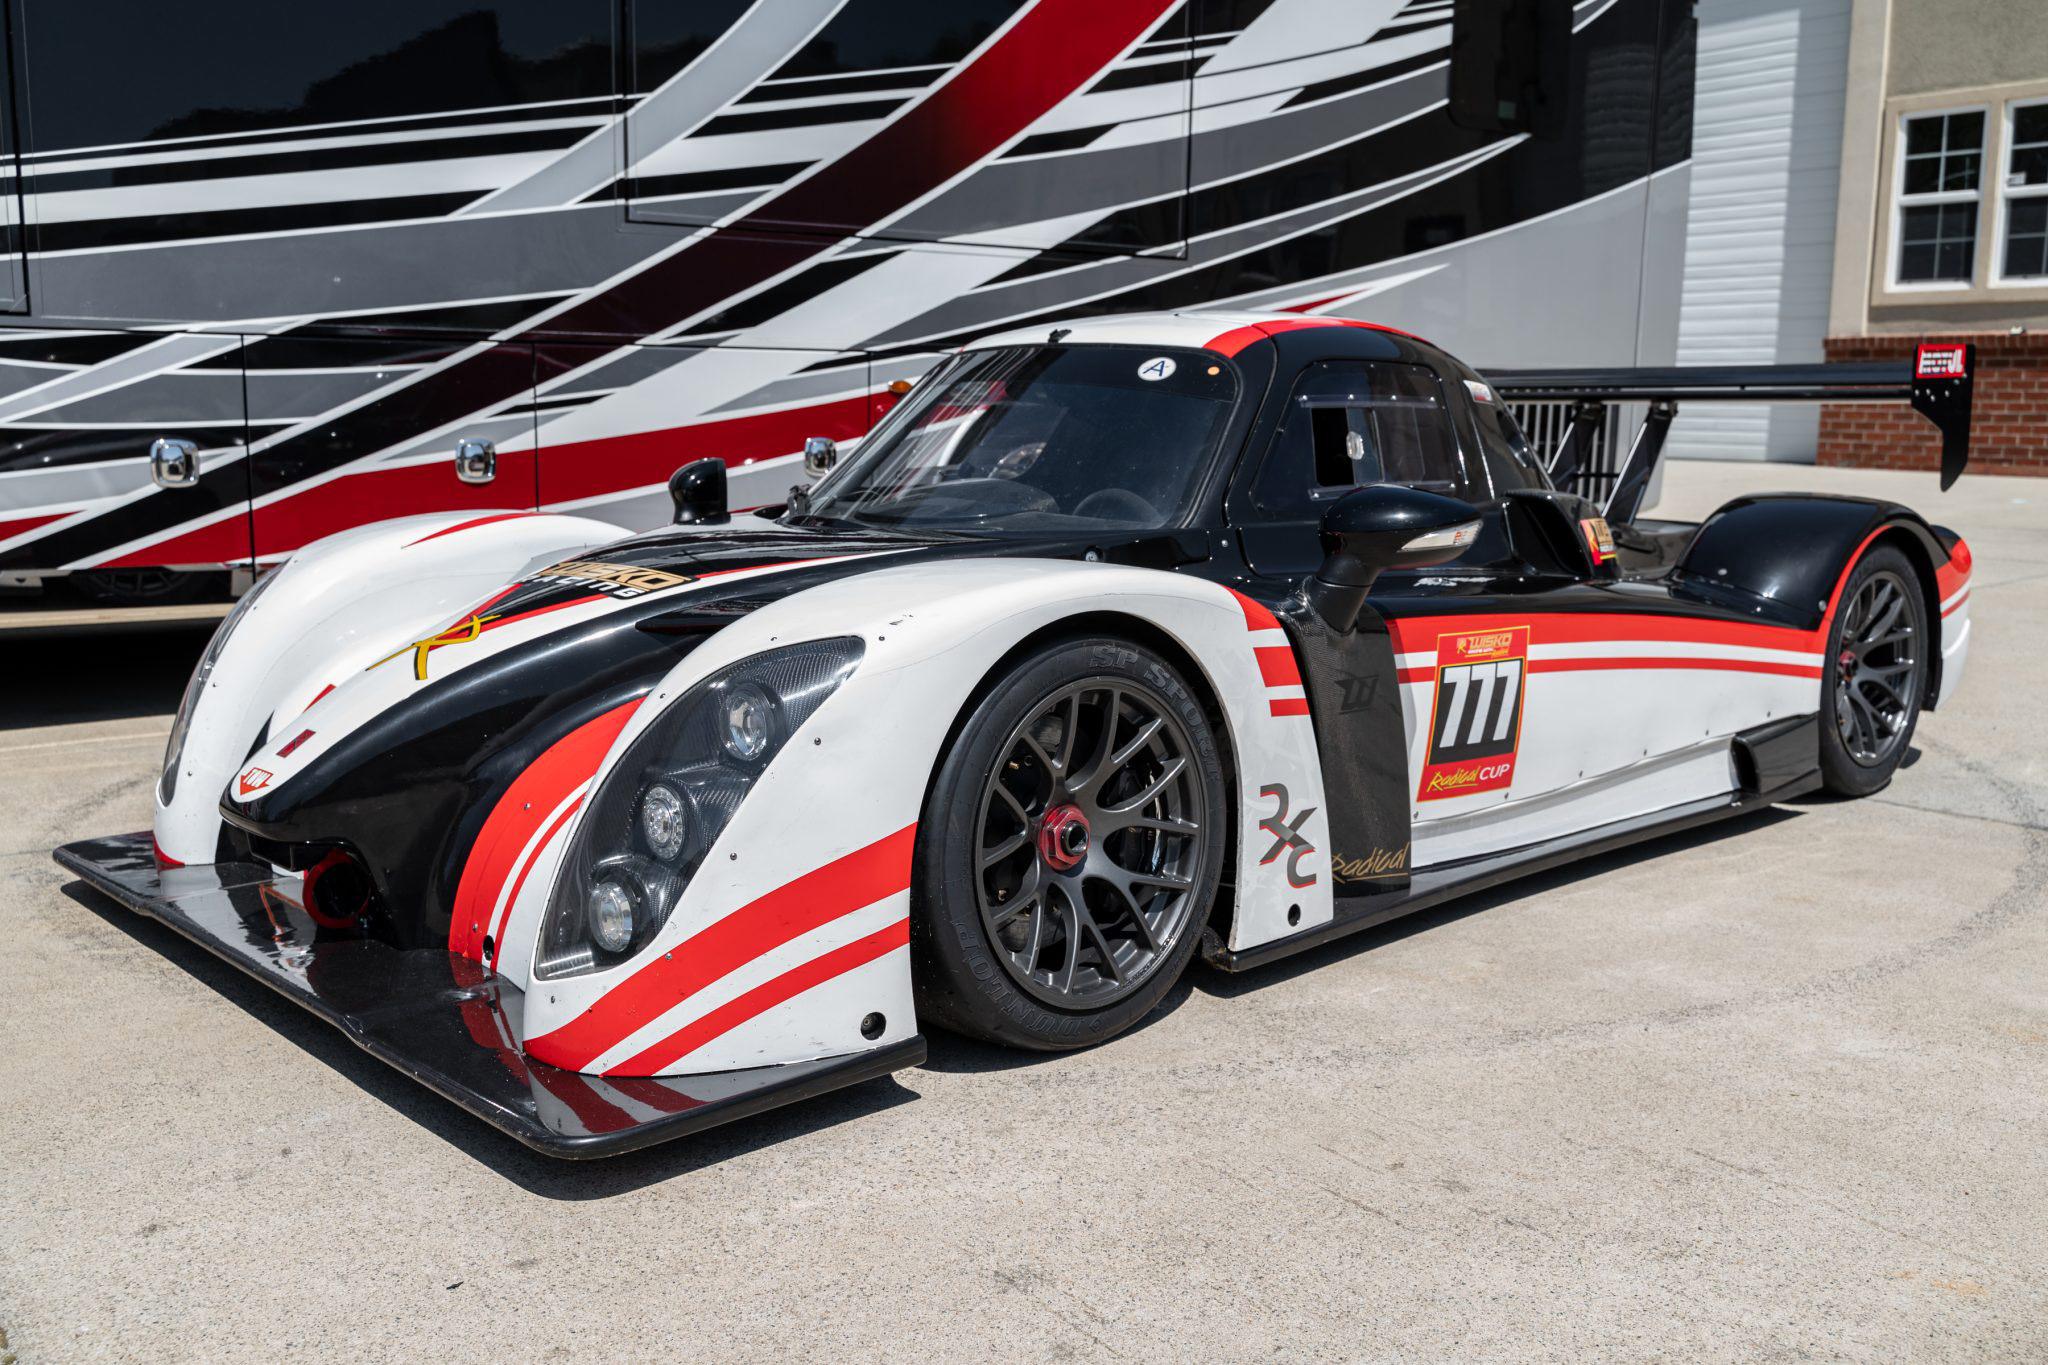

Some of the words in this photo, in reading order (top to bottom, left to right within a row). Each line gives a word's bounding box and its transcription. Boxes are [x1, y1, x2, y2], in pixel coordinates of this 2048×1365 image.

[1142, 360, 1165, 377] A
[1439, 660, 1521, 748] 777
[1479, 763, 1511, 781] CUP
